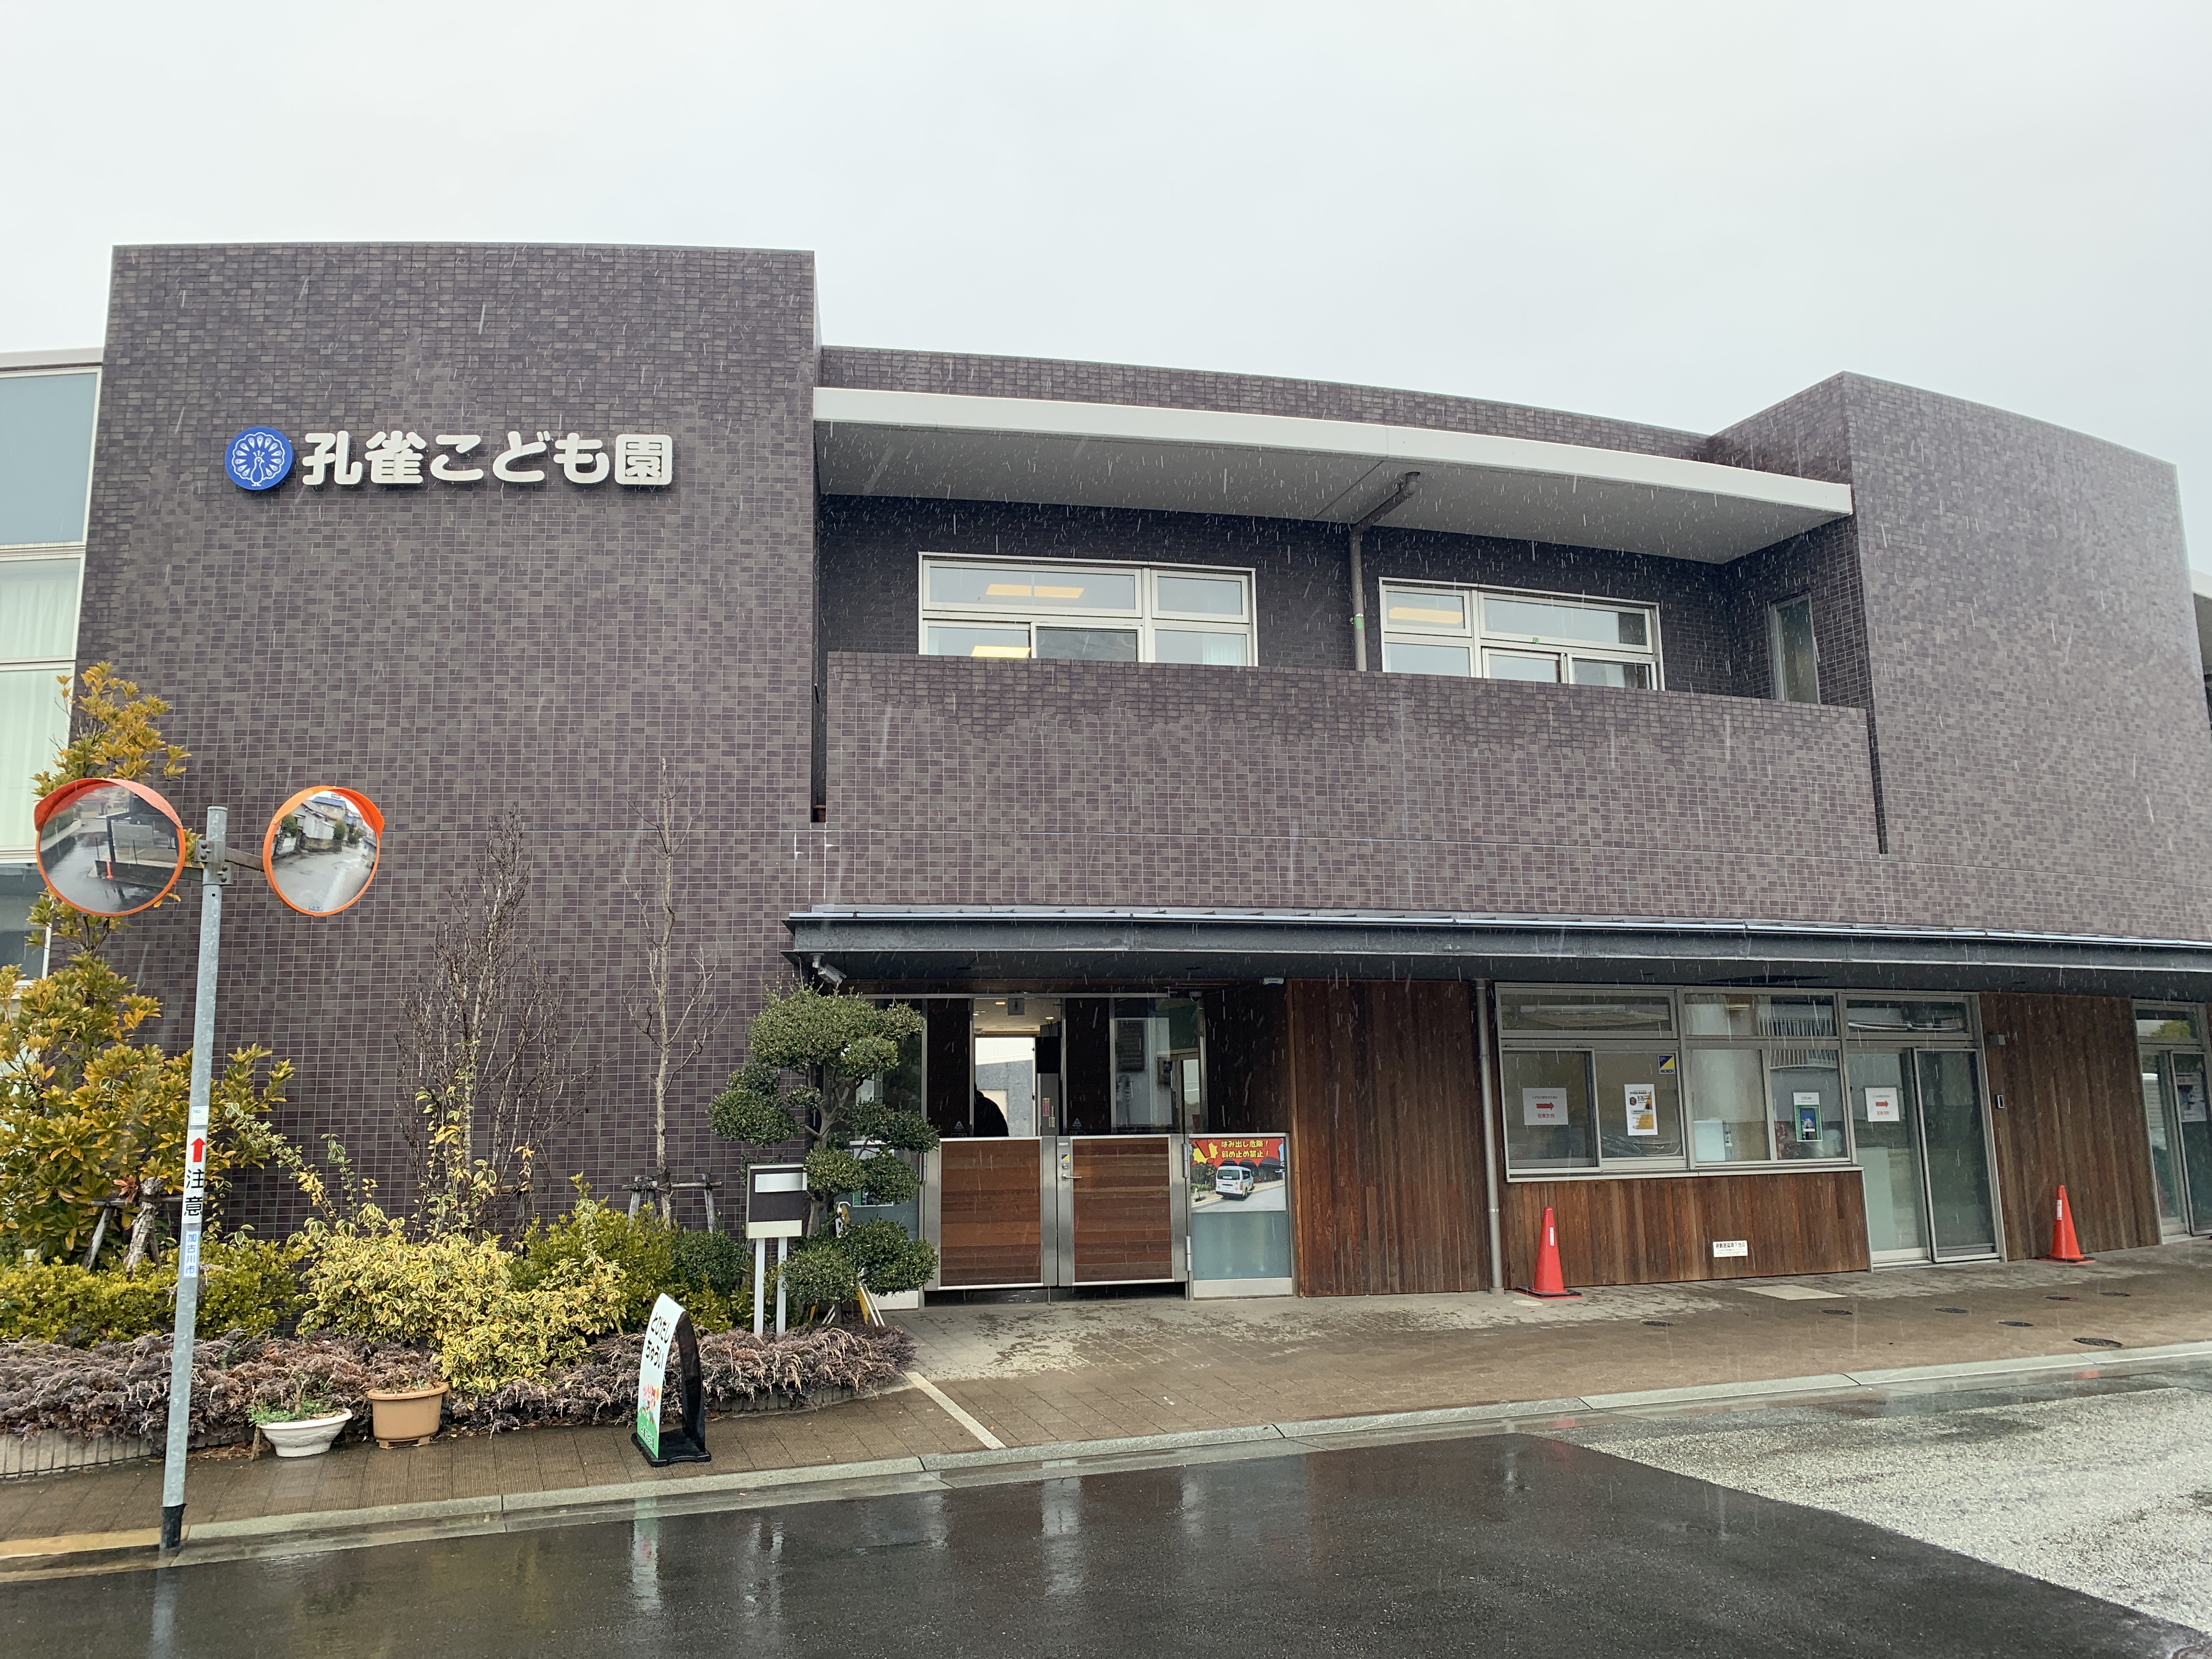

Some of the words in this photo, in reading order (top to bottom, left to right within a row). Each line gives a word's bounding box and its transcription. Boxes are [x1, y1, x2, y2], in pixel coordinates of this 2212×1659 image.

[302, 430, 672, 485] 孔雀こども園
[1221, 1139, 1268, 1148] はみ出し危険！
[1221, 1150, 1269, 1158] 斜め止め禁止！
[184, 1169, 205, 1216] 注意
[185, 1233, 197, 1274] 加古川市
